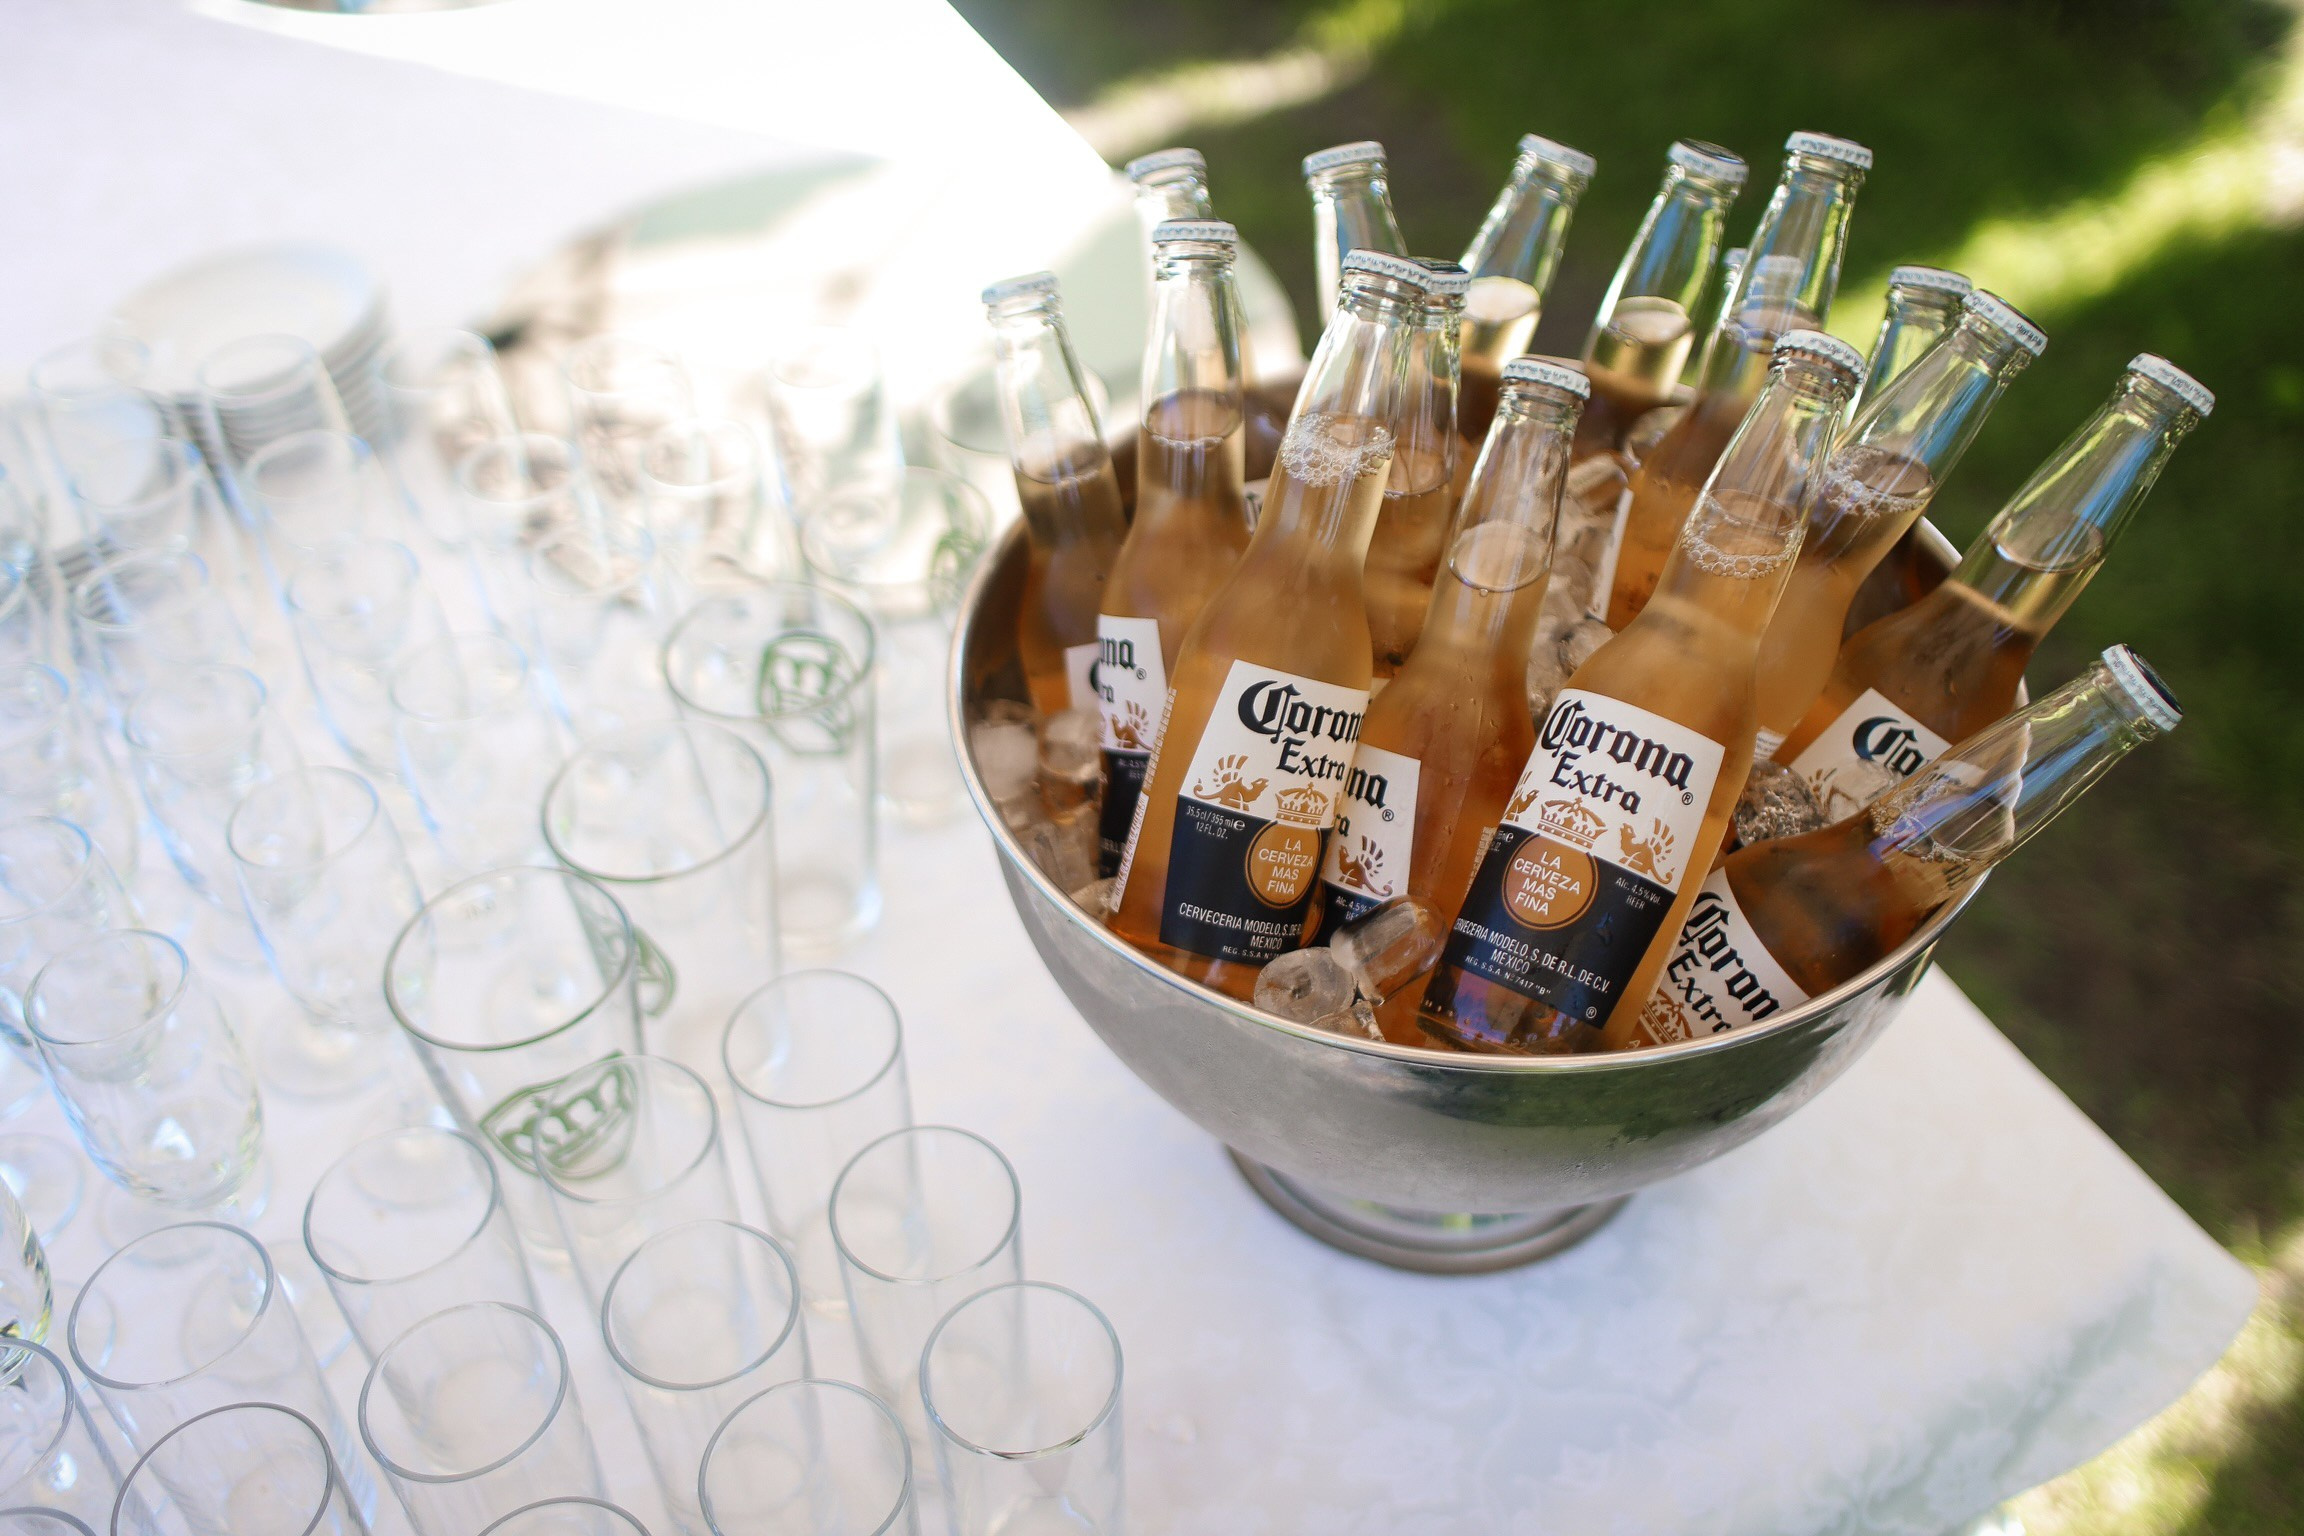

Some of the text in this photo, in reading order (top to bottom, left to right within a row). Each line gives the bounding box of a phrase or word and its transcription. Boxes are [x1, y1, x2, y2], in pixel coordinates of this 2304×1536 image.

[1238, 680, 1366, 745] Coron
[1540, 699, 1695, 791] Corona
[1275, 737, 1346, 782] Extra
[1549, 750, 1641, 815] Extra
[1285, 838, 1302, 851] LA
[1258, 848, 1314, 867] CERVEZA
[1540, 851, 1561, 869] LA
[1272, 867, 1300, 881] MAS
[1513, 858, 1581, 895] CERVEZA
[1615, 877, 1629, 891] Alc.
[1267, 879, 1296, 895] FINA
[1522, 878, 1556, 901] MAS
[1515, 891, 1549, 915] FINA
[1626, 896, 1646, 910] BEER
[1179, 902, 1242, 930] CERVECERIA
[1250, 935, 1283, 950] MEXICO
[1491, 948, 1530, 975] MEXICO
[1530, 948, 1540, 963] S.
[1541, 953, 1558, 971] DE
[1679, 891, 1780, 1022] Coron
[1515, 974, 1534, 989] 7417
